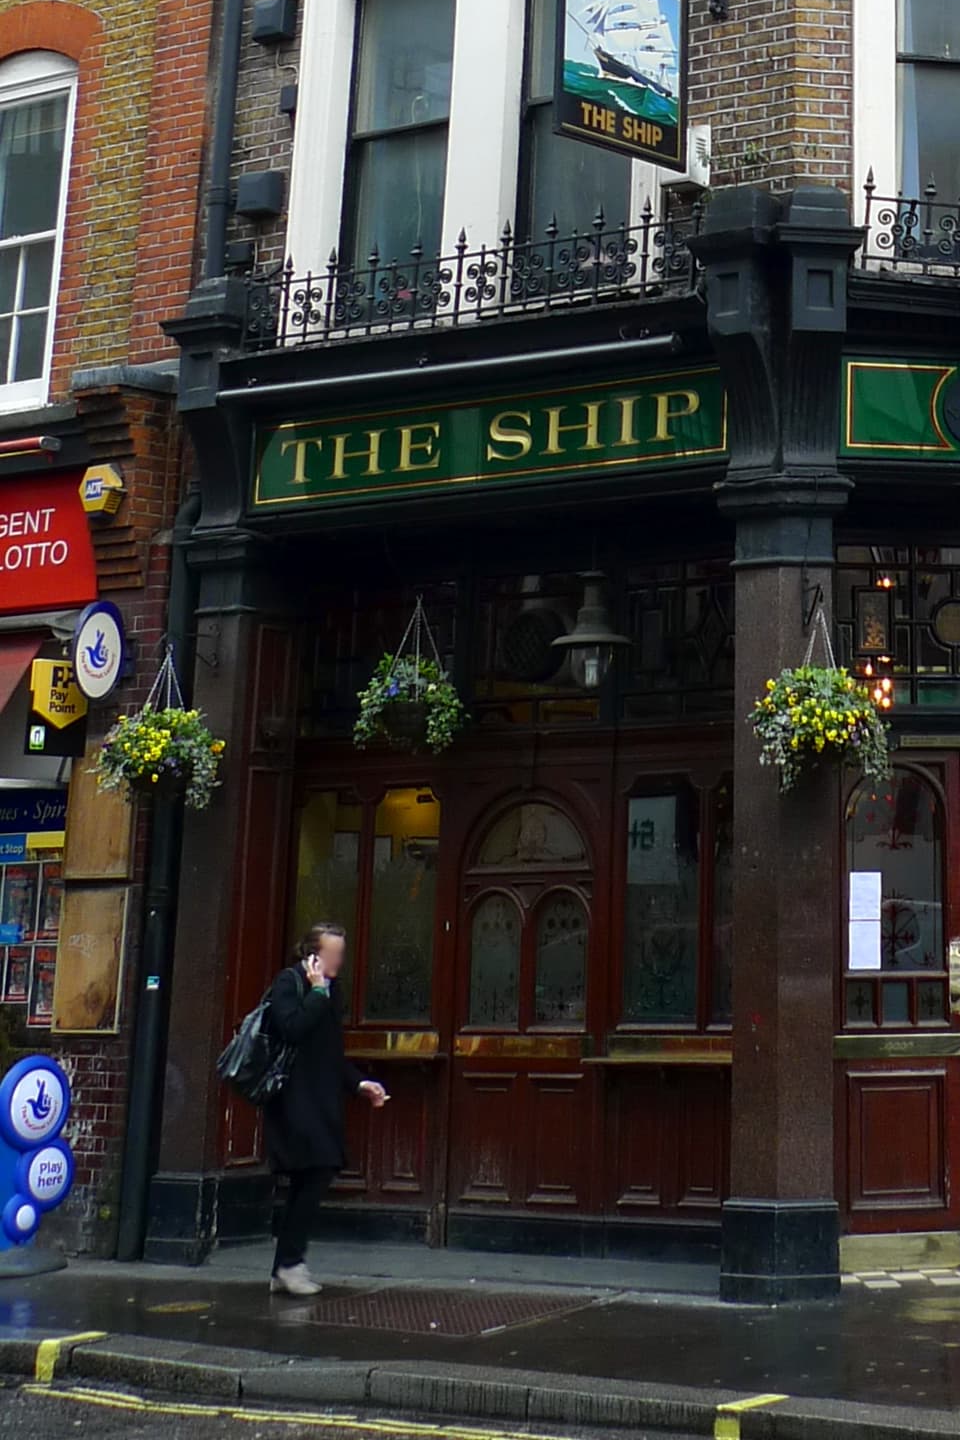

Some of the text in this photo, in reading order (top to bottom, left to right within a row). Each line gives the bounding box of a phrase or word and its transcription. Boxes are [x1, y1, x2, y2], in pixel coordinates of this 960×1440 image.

[581, 102, 663, 147] THE SHIP
[280, 388, 700, 485] THE SHIP
[0, 540, 68, 571] OTTO
[50, 689, 69, 702] Pay
[49, 701, 76, 714] Point
[39, 1160, 62, 1176] Play
[37, 1172, 63, 1188] here
